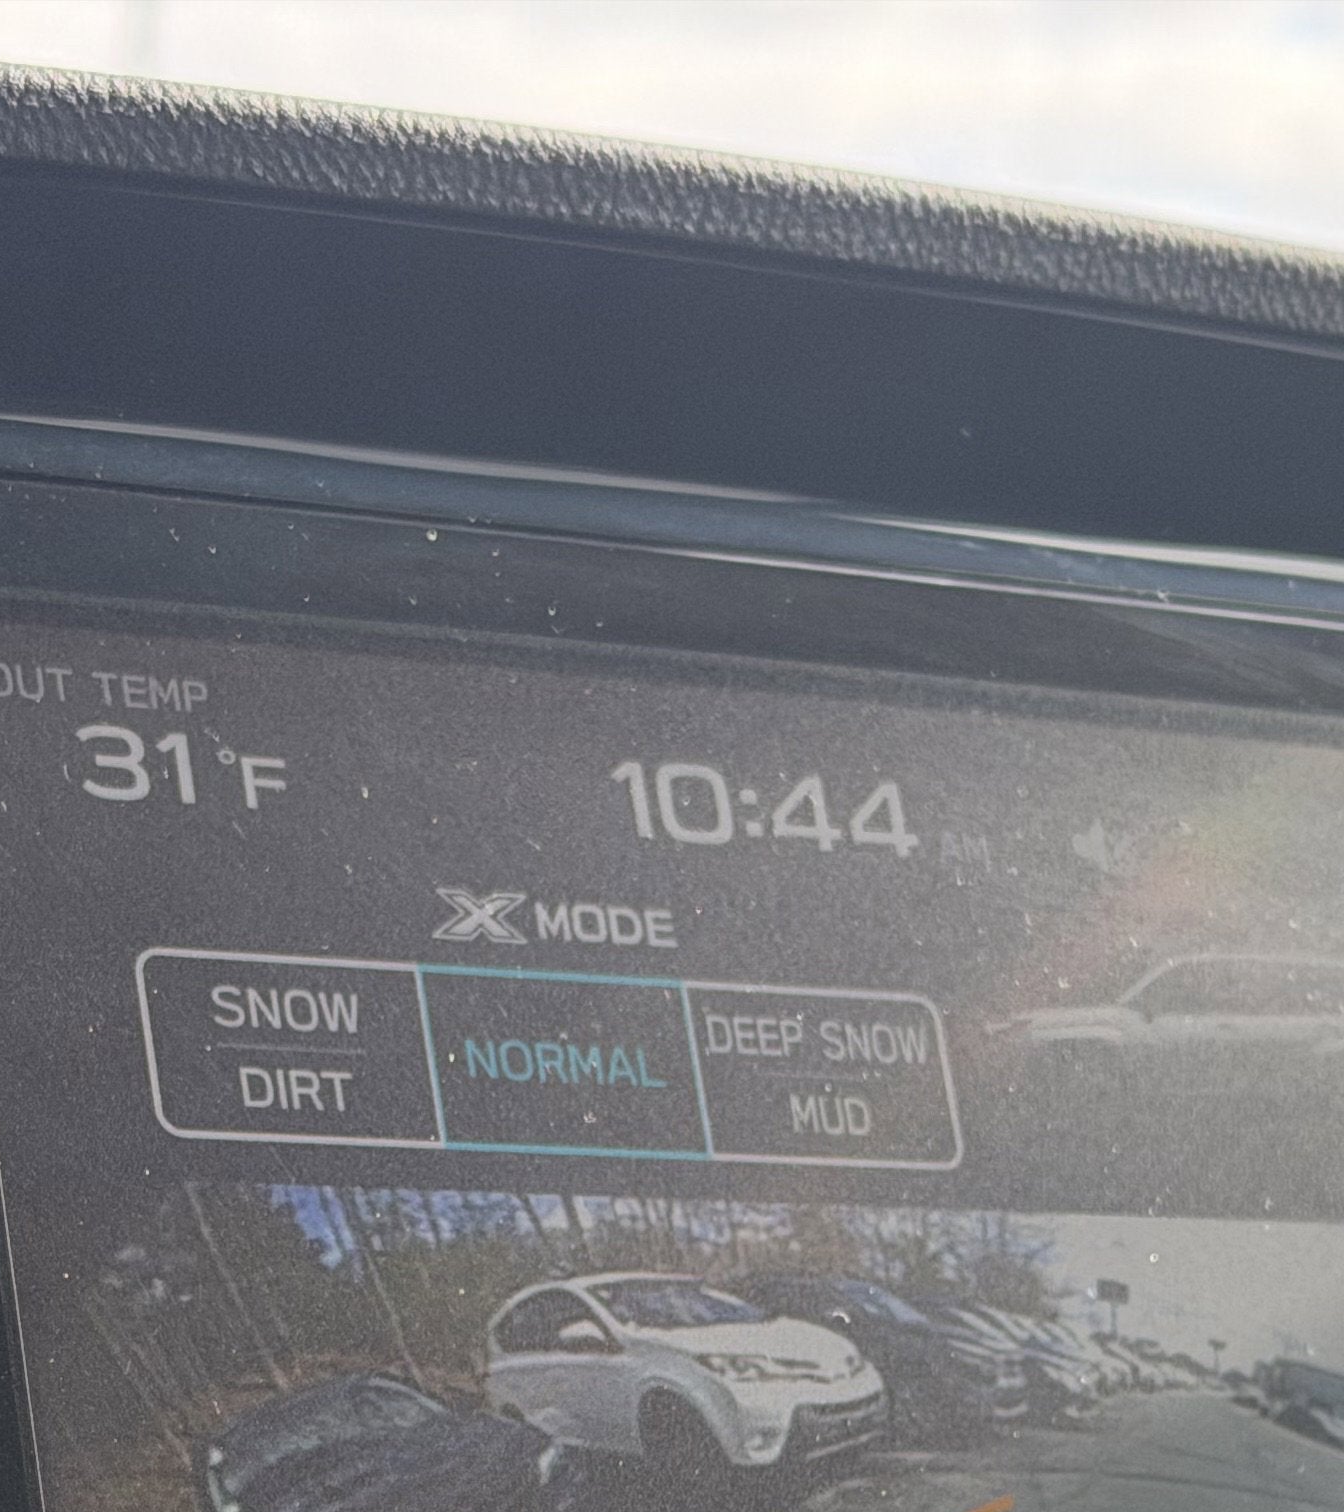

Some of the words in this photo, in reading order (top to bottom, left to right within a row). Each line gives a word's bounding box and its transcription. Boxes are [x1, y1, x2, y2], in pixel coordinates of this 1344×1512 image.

[91, 671, 209, 712] TEMP
[612, 761, 919, 858] 10:44
[534, 903, 679, 949] MODE
[210, 985, 363, 1034] SNOW
[463, 1038, 668, 1089] NORMAL
[705, 1015, 803, 1057] DEEP
[820, 1021, 927, 1065] SNOW
[239, 1067, 354, 1112] DIRT
[790, 1094, 872, 1137] MUD
